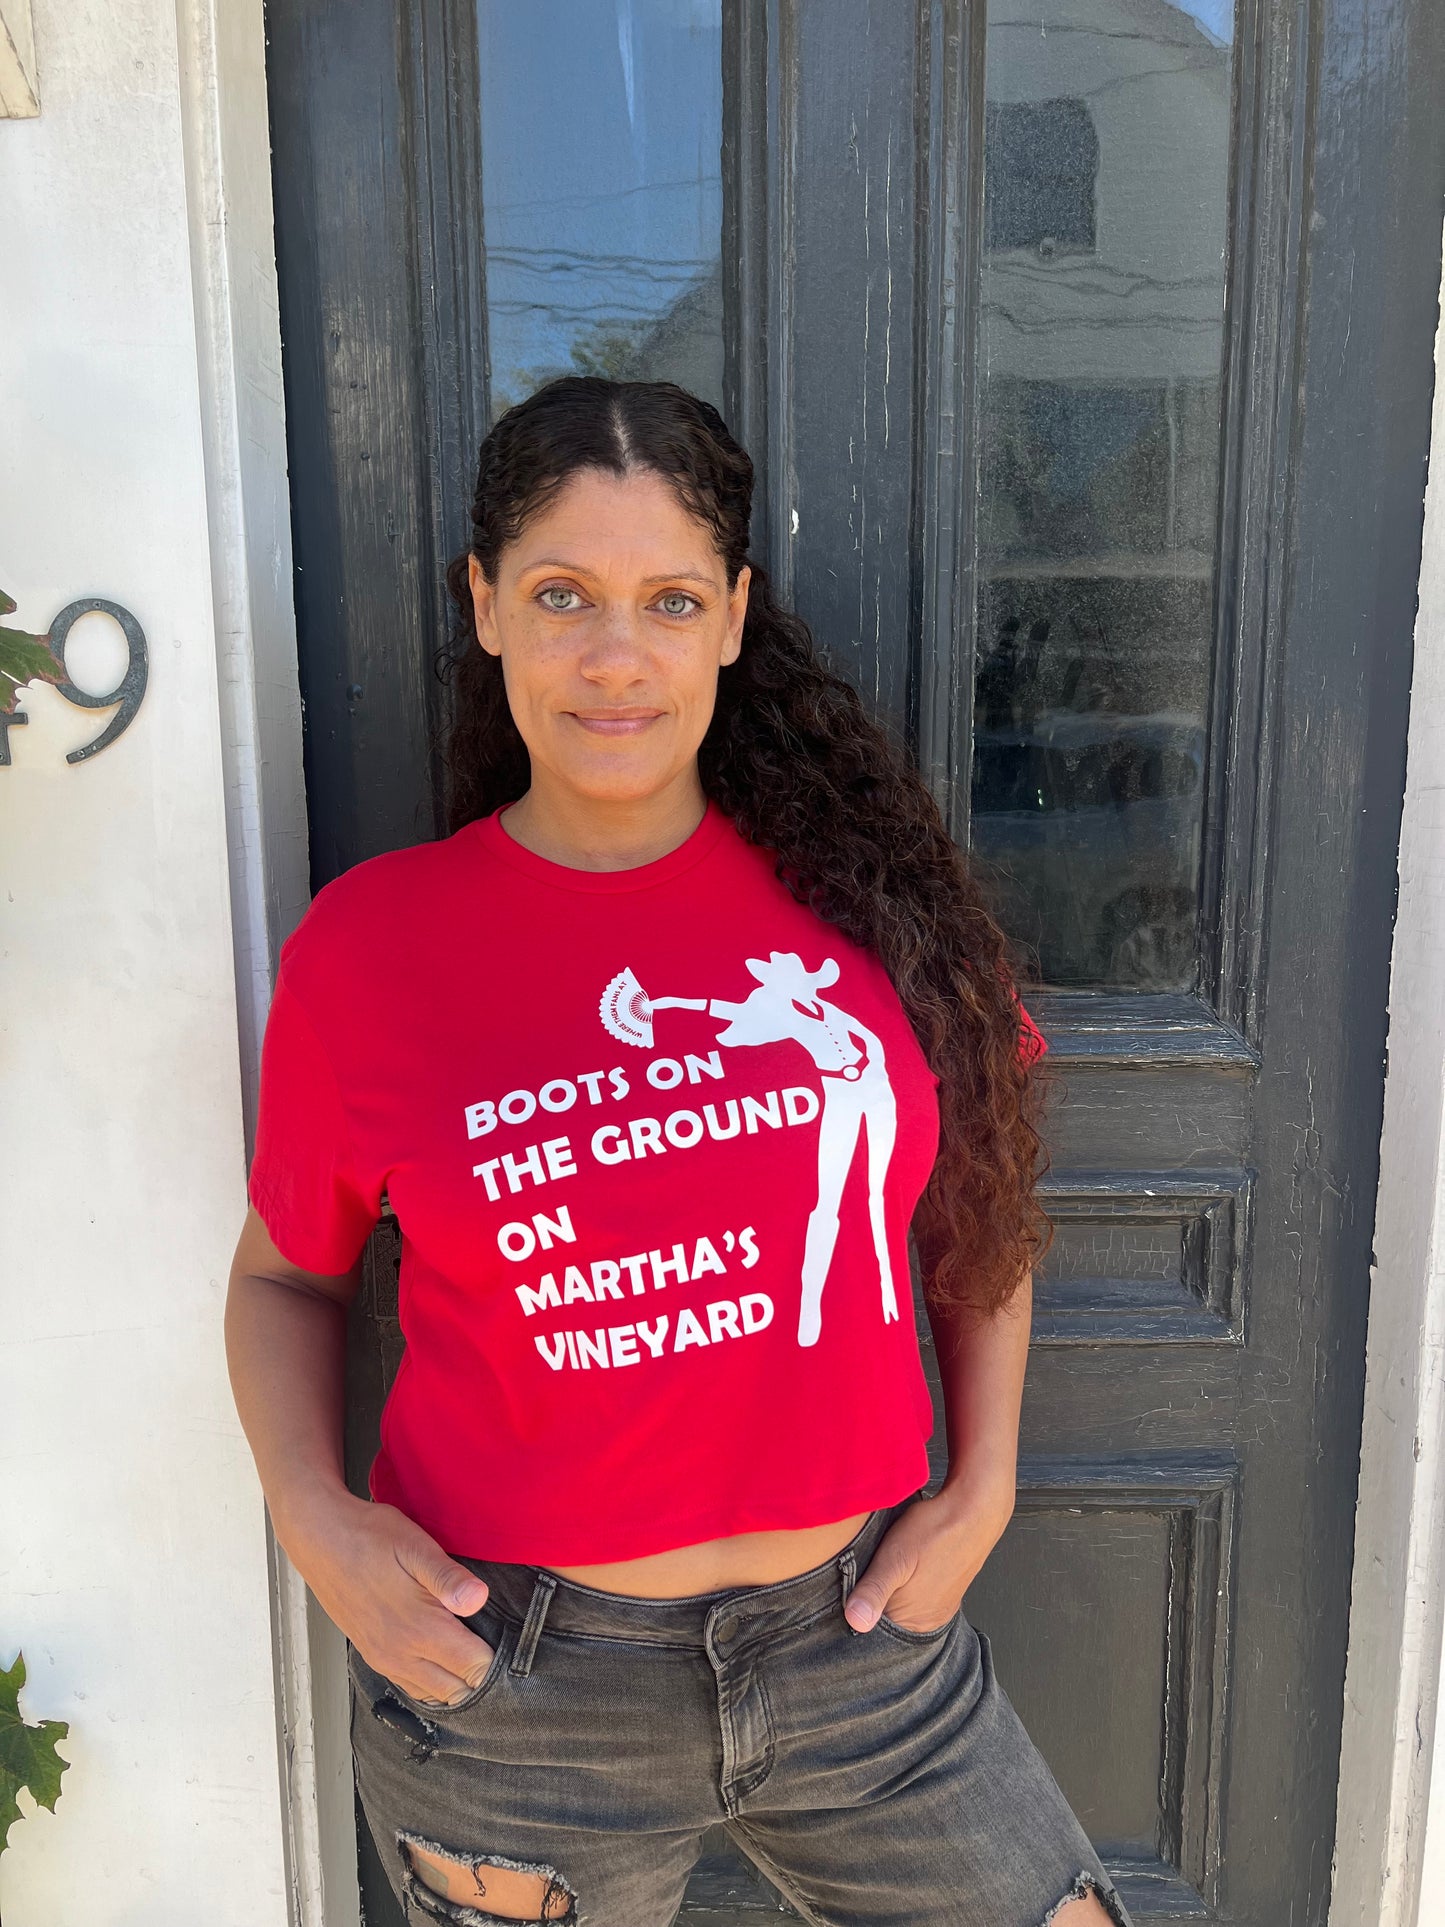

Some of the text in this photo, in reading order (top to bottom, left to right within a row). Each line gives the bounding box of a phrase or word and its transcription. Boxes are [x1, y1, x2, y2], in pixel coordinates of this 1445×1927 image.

[610, 981, 643, 1038] WHERE THEM FANS AT
[464, 1050, 725, 1139] BOOTS ON
[472, 1086, 820, 1201] THE GROUND
[497, 1206, 577, 1262] ON
[514, 1225, 760, 1317] MARTHA’S
[533, 1292, 775, 1371] VINEYARD
